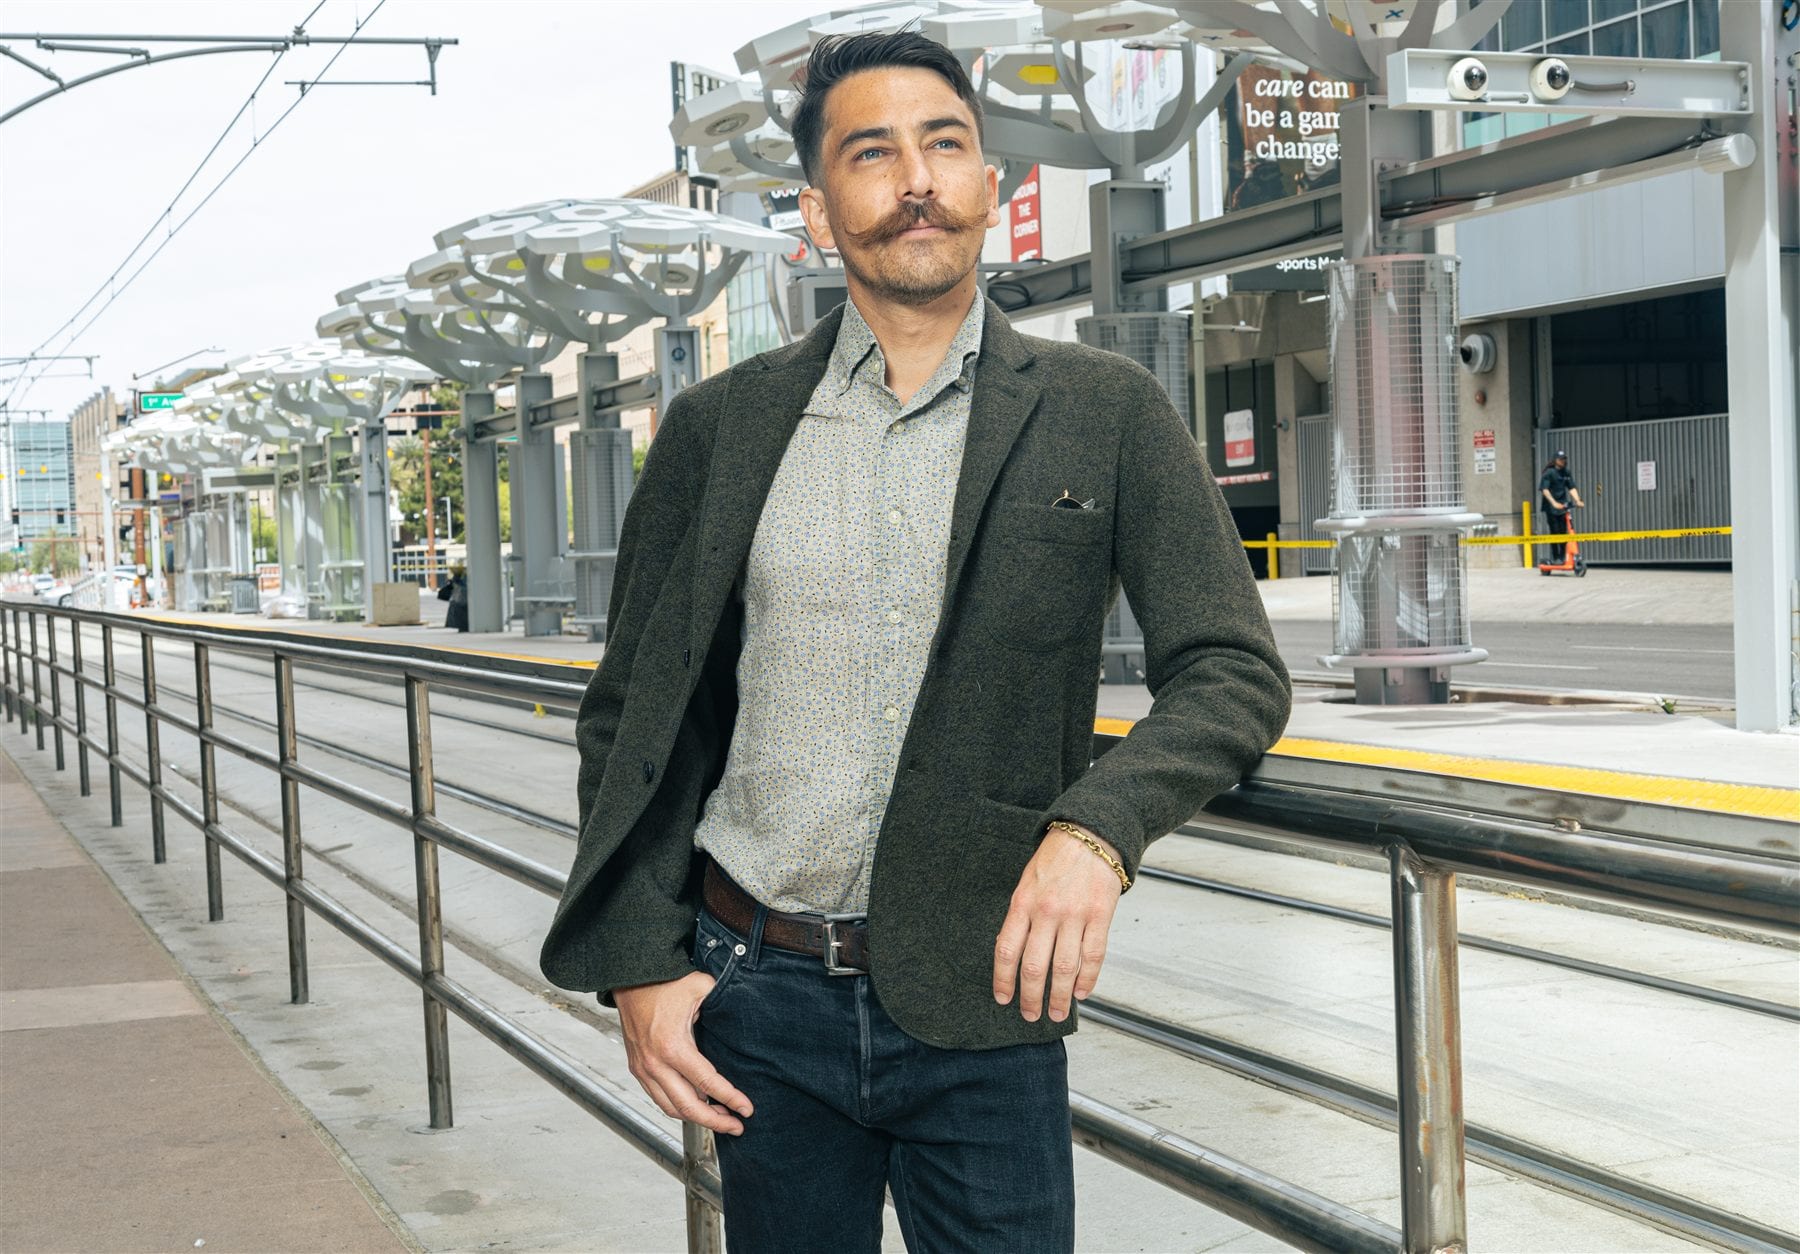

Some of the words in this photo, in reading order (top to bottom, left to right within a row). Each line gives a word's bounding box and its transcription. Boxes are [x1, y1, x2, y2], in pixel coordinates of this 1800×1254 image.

[1254, 78, 1304, 97] care
[1308, 80, 1349, 98] can
[1245, 103, 1275, 127] be
[1280, 110, 1294, 128] a
[1298, 110, 1341, 135] gam
[1256, 134, 1341, 166] change
